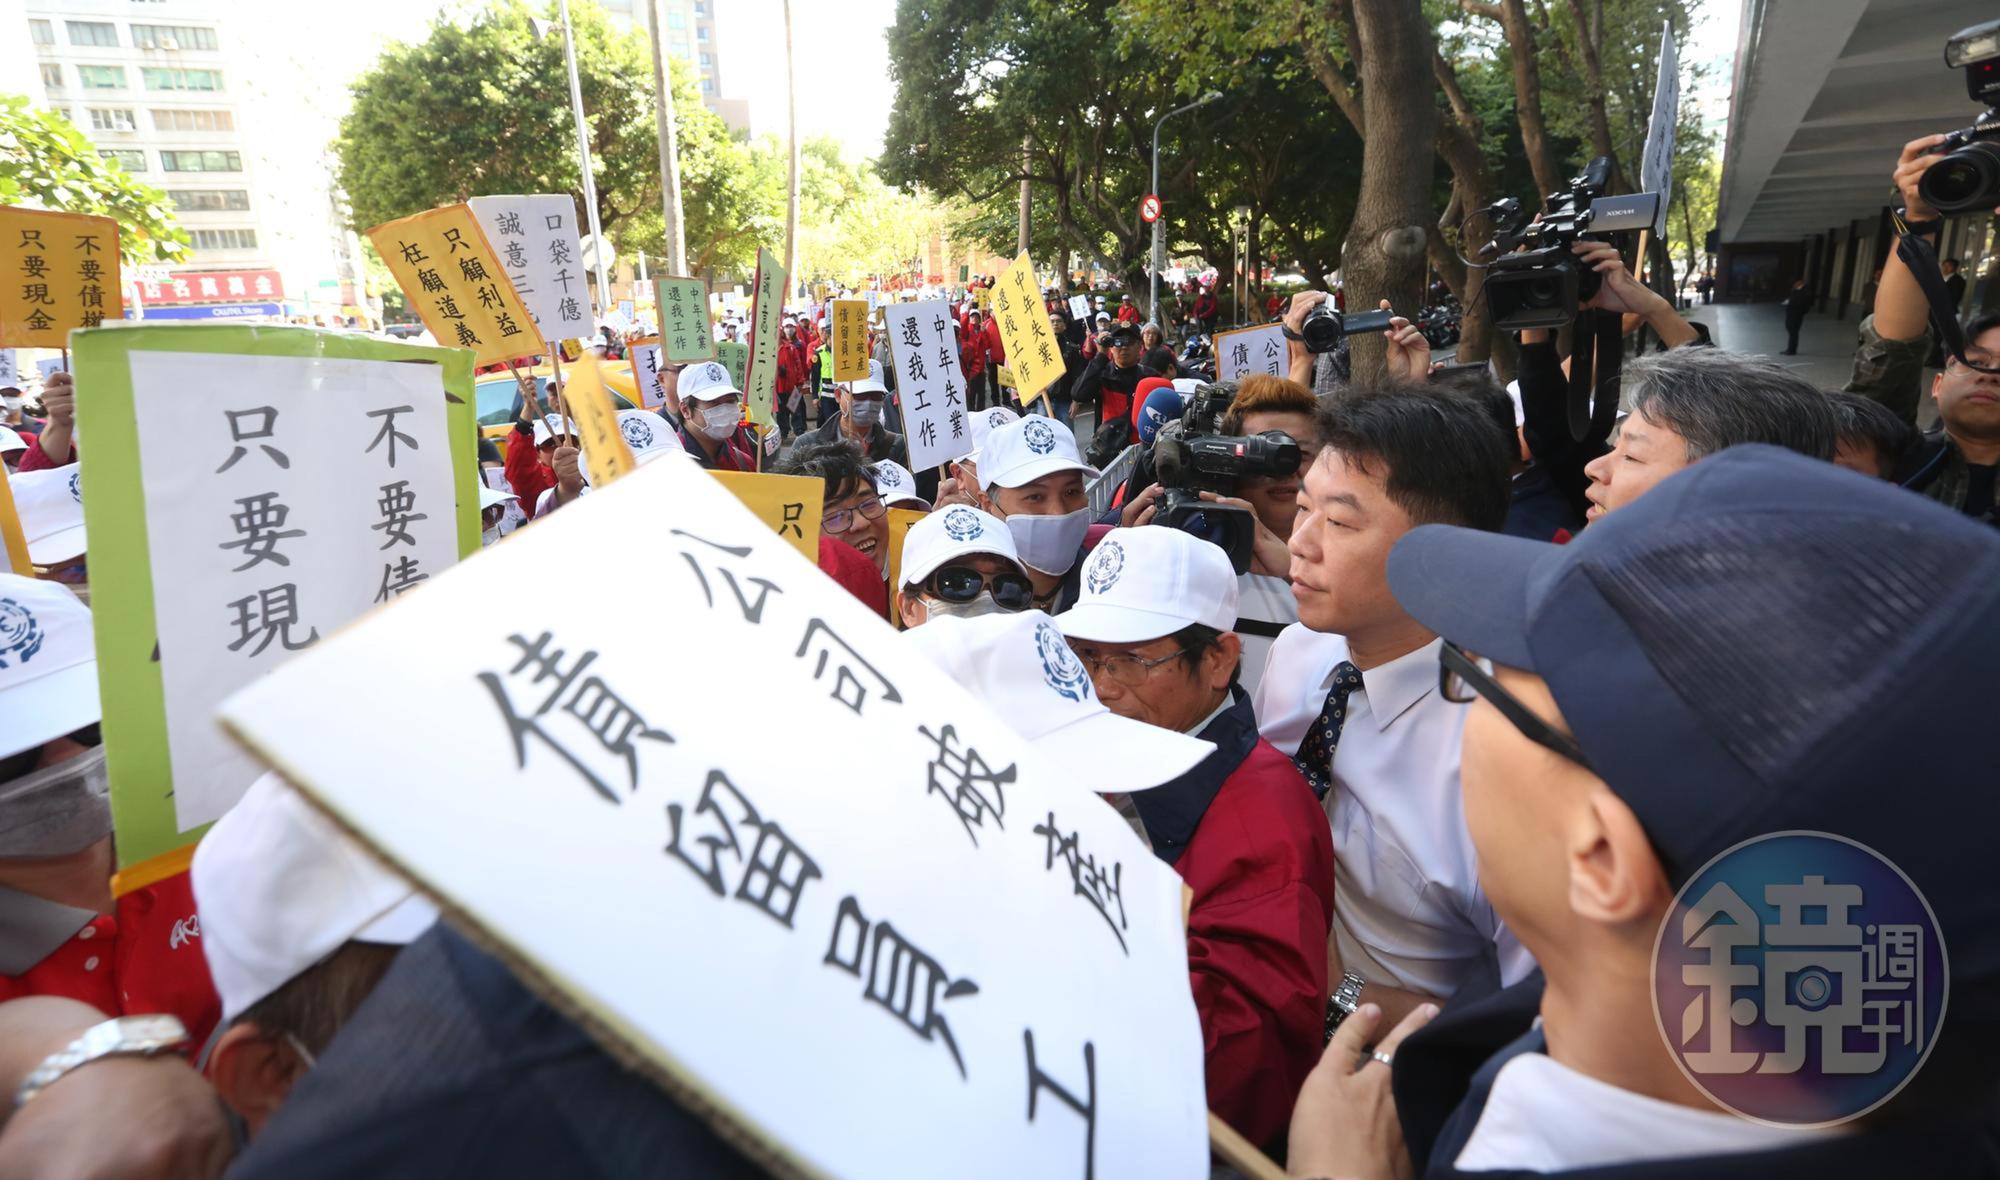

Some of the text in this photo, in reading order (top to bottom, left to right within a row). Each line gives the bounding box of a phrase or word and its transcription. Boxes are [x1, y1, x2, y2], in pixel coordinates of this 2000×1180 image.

[18, 229, 56, 330] 只要現金
[75, 235, 106, 328] 不要債權
[398, 240, 483, 347] 枉顧道義
[443, 227, 522, 338] 只顧利益
[545, 214, 582, 322] 口袋千億
[668, 287, 687, 351] 還我工作
[689, 286, 707, 350] 中年失業
[839, 307, 850, 371] 債留員工
[855, 307, 865, 371] 公司破產
[998, 288, 1030, 383] 還我工作
[1014, 270, 1053, 368] 中年失業
[1263, 338, 1280, 377] 公司
[901, 316, 937, 448] 還我工作
[933, 313, 963, 440] 中年失業
[215, 405, 321, 658] 只要現
[778, 502, 804, 540] 只
[670, 528, 1129, 956] 公司破產
[476, 630, 1096, 1180] 債留員工
